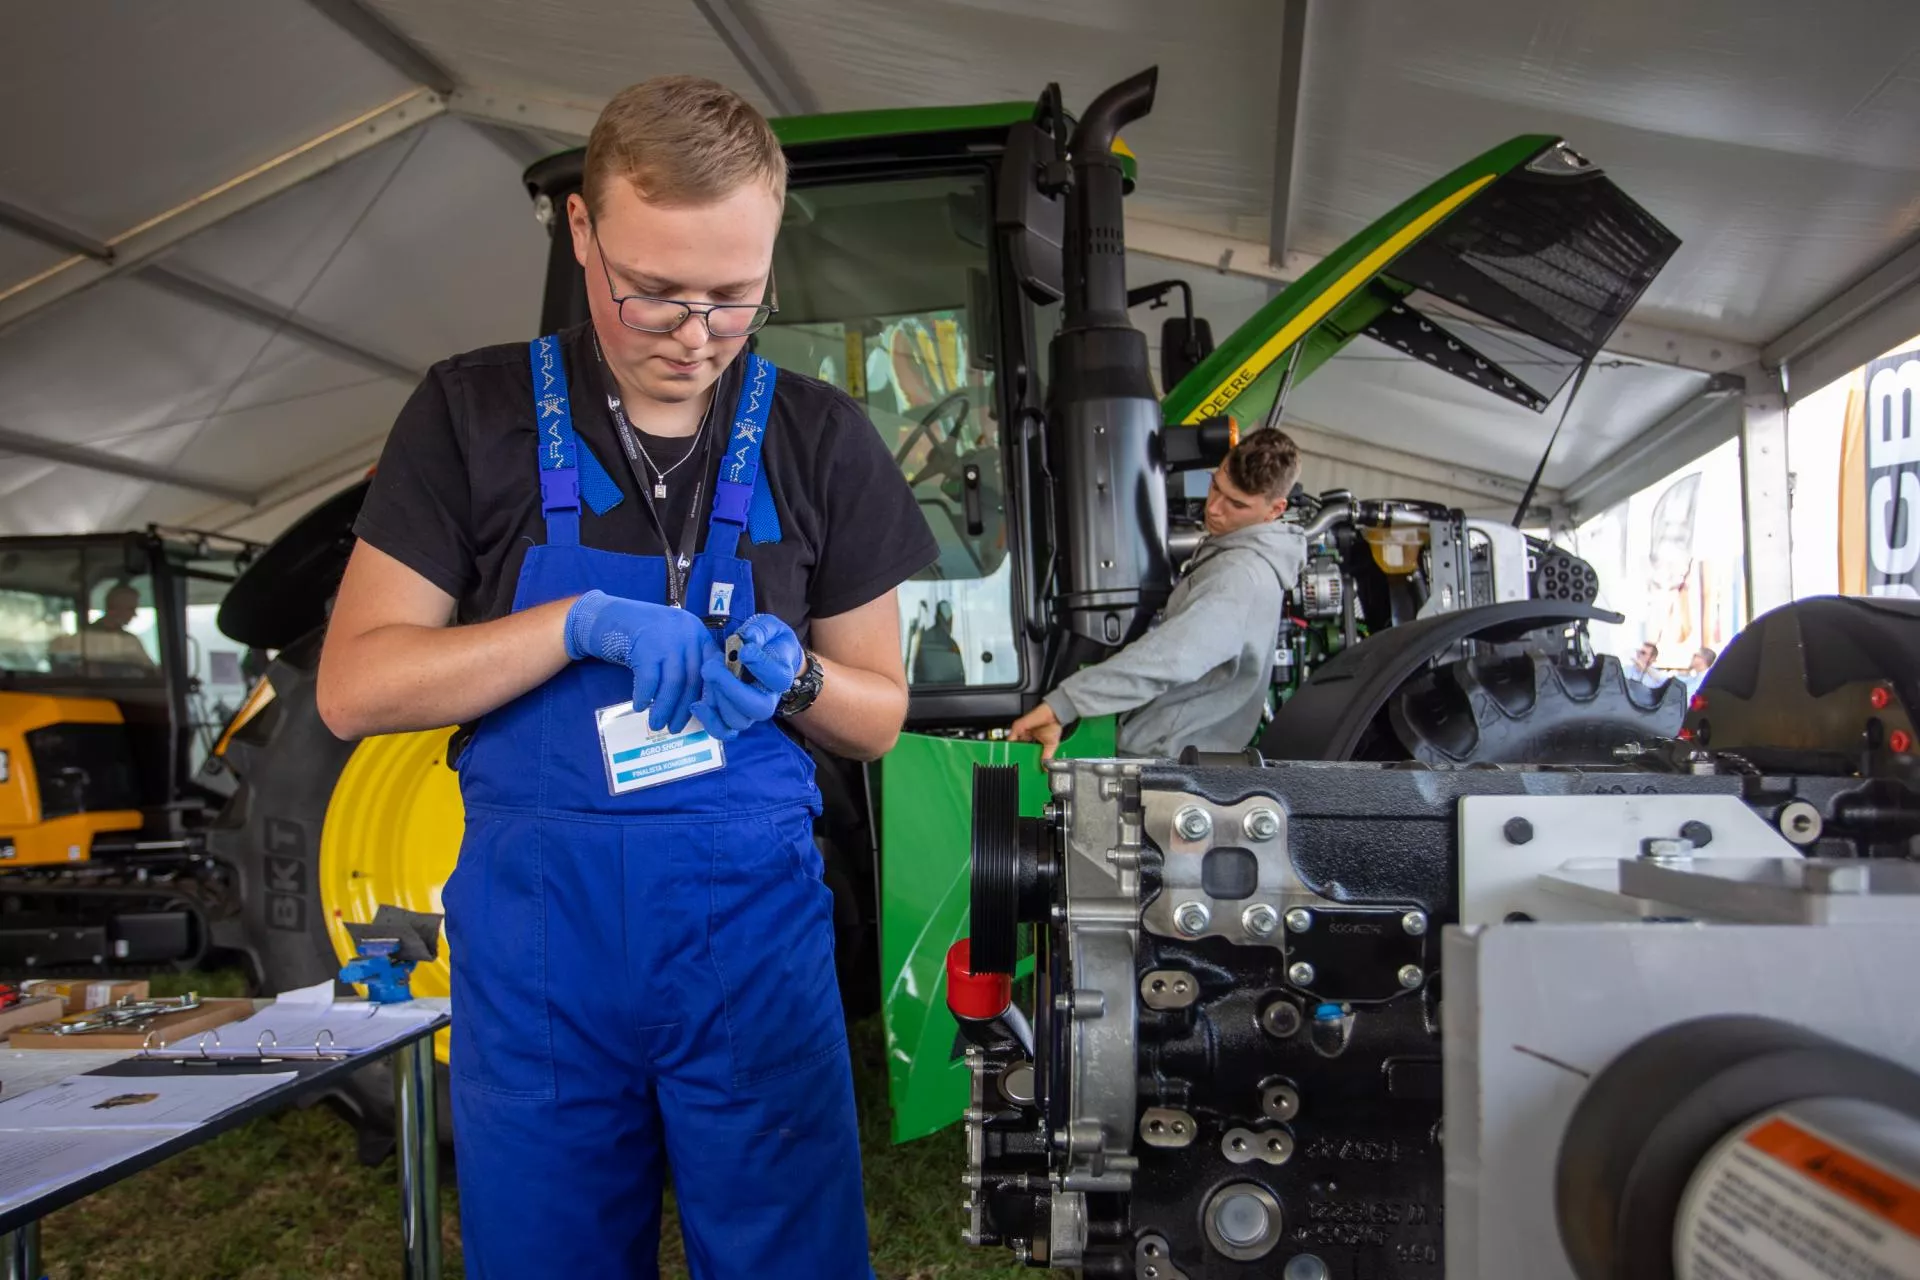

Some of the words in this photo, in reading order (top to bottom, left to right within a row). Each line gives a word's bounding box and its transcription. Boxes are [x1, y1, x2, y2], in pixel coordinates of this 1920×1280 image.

[1200, 368, 1255, 418] DEERE
[1869, 360, 1920, 597] CB
[640, 746, 661, 758] AGRO
[662, 739, 684, 752] SHOW
[271, 821, 300, 928] BKT
